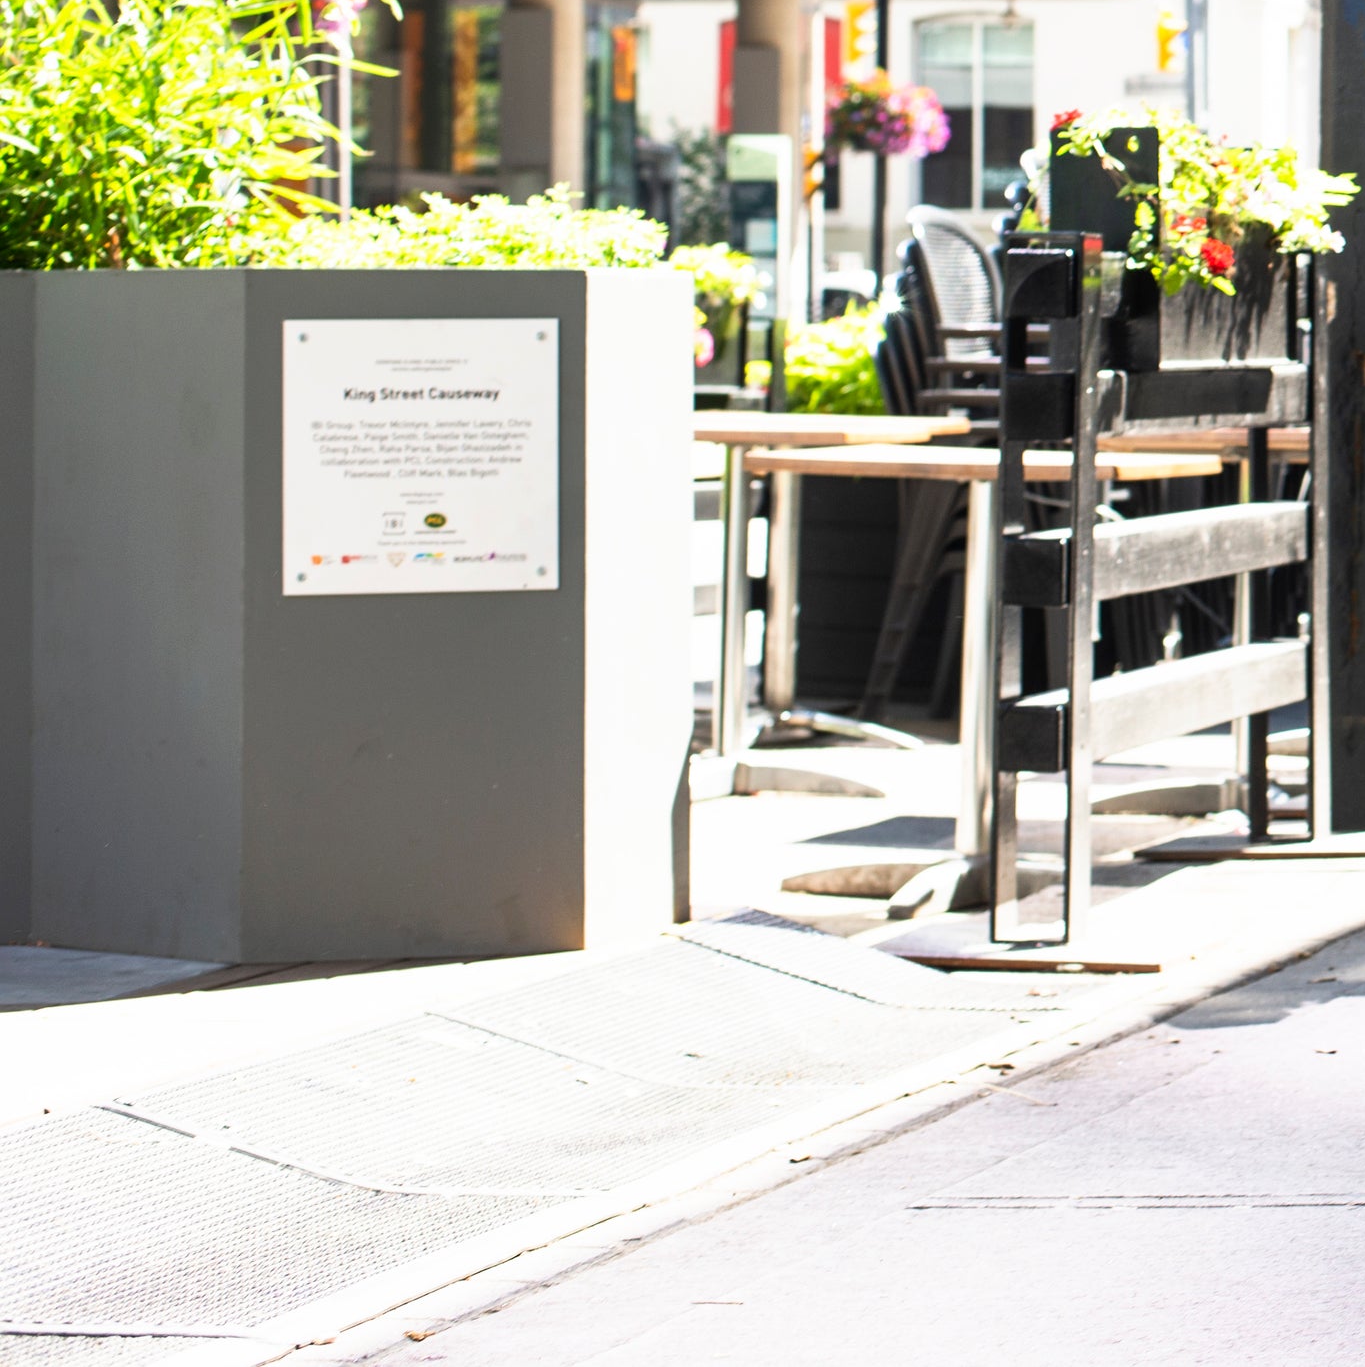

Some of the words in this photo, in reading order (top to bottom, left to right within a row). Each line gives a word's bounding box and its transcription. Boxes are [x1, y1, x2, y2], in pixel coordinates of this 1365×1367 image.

[343, 387, 376, 403] King
[379, 387, 425, 402] Street
[428, 386, 501, 403] Causeway
